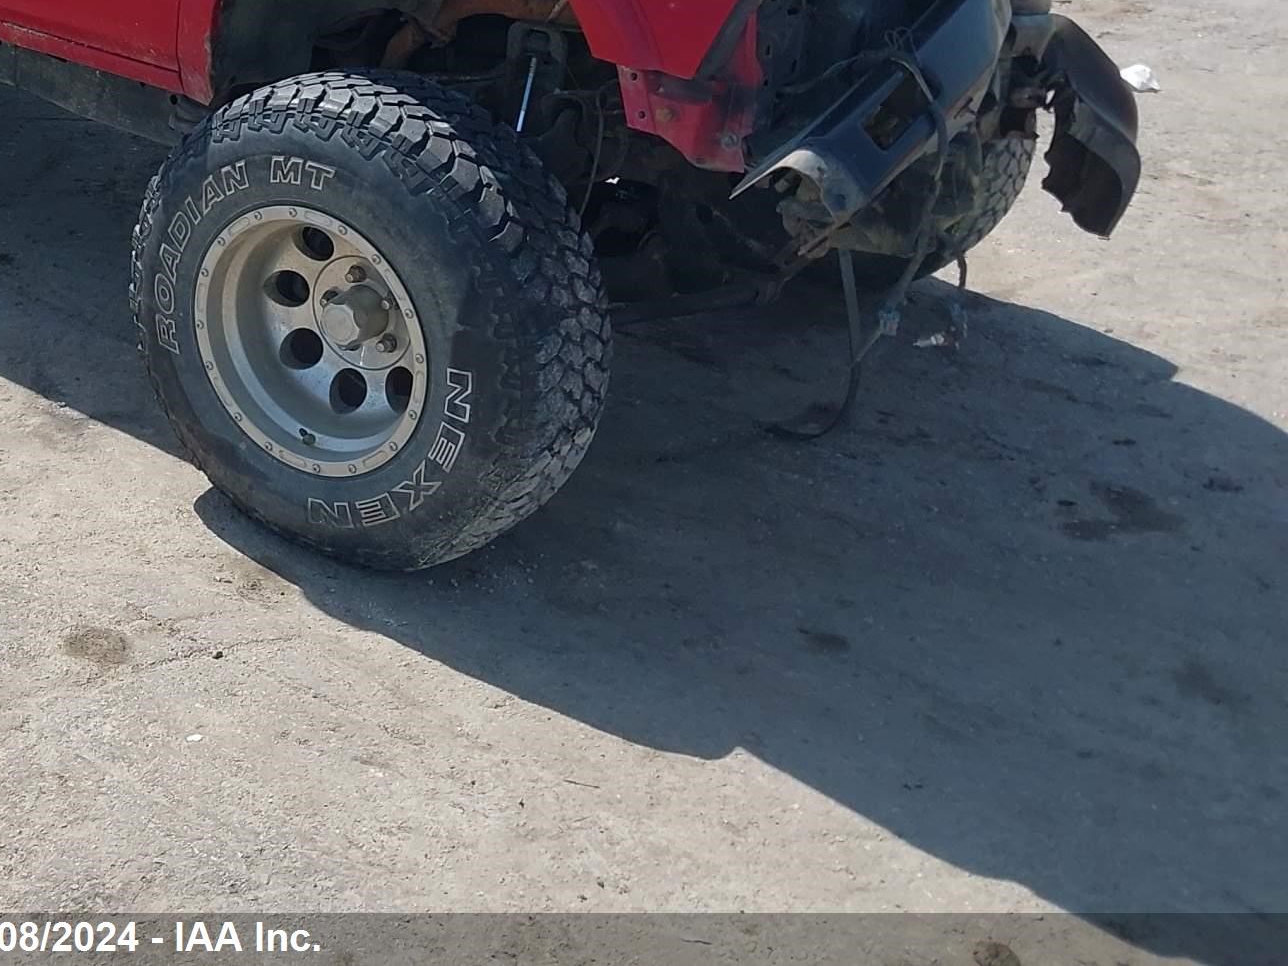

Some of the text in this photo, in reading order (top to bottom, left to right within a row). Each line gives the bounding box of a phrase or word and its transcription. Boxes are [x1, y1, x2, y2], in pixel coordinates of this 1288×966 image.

[154, 155, 336, 355] ROADIAN MT
[307, 367, 473, 529] NEXEN
